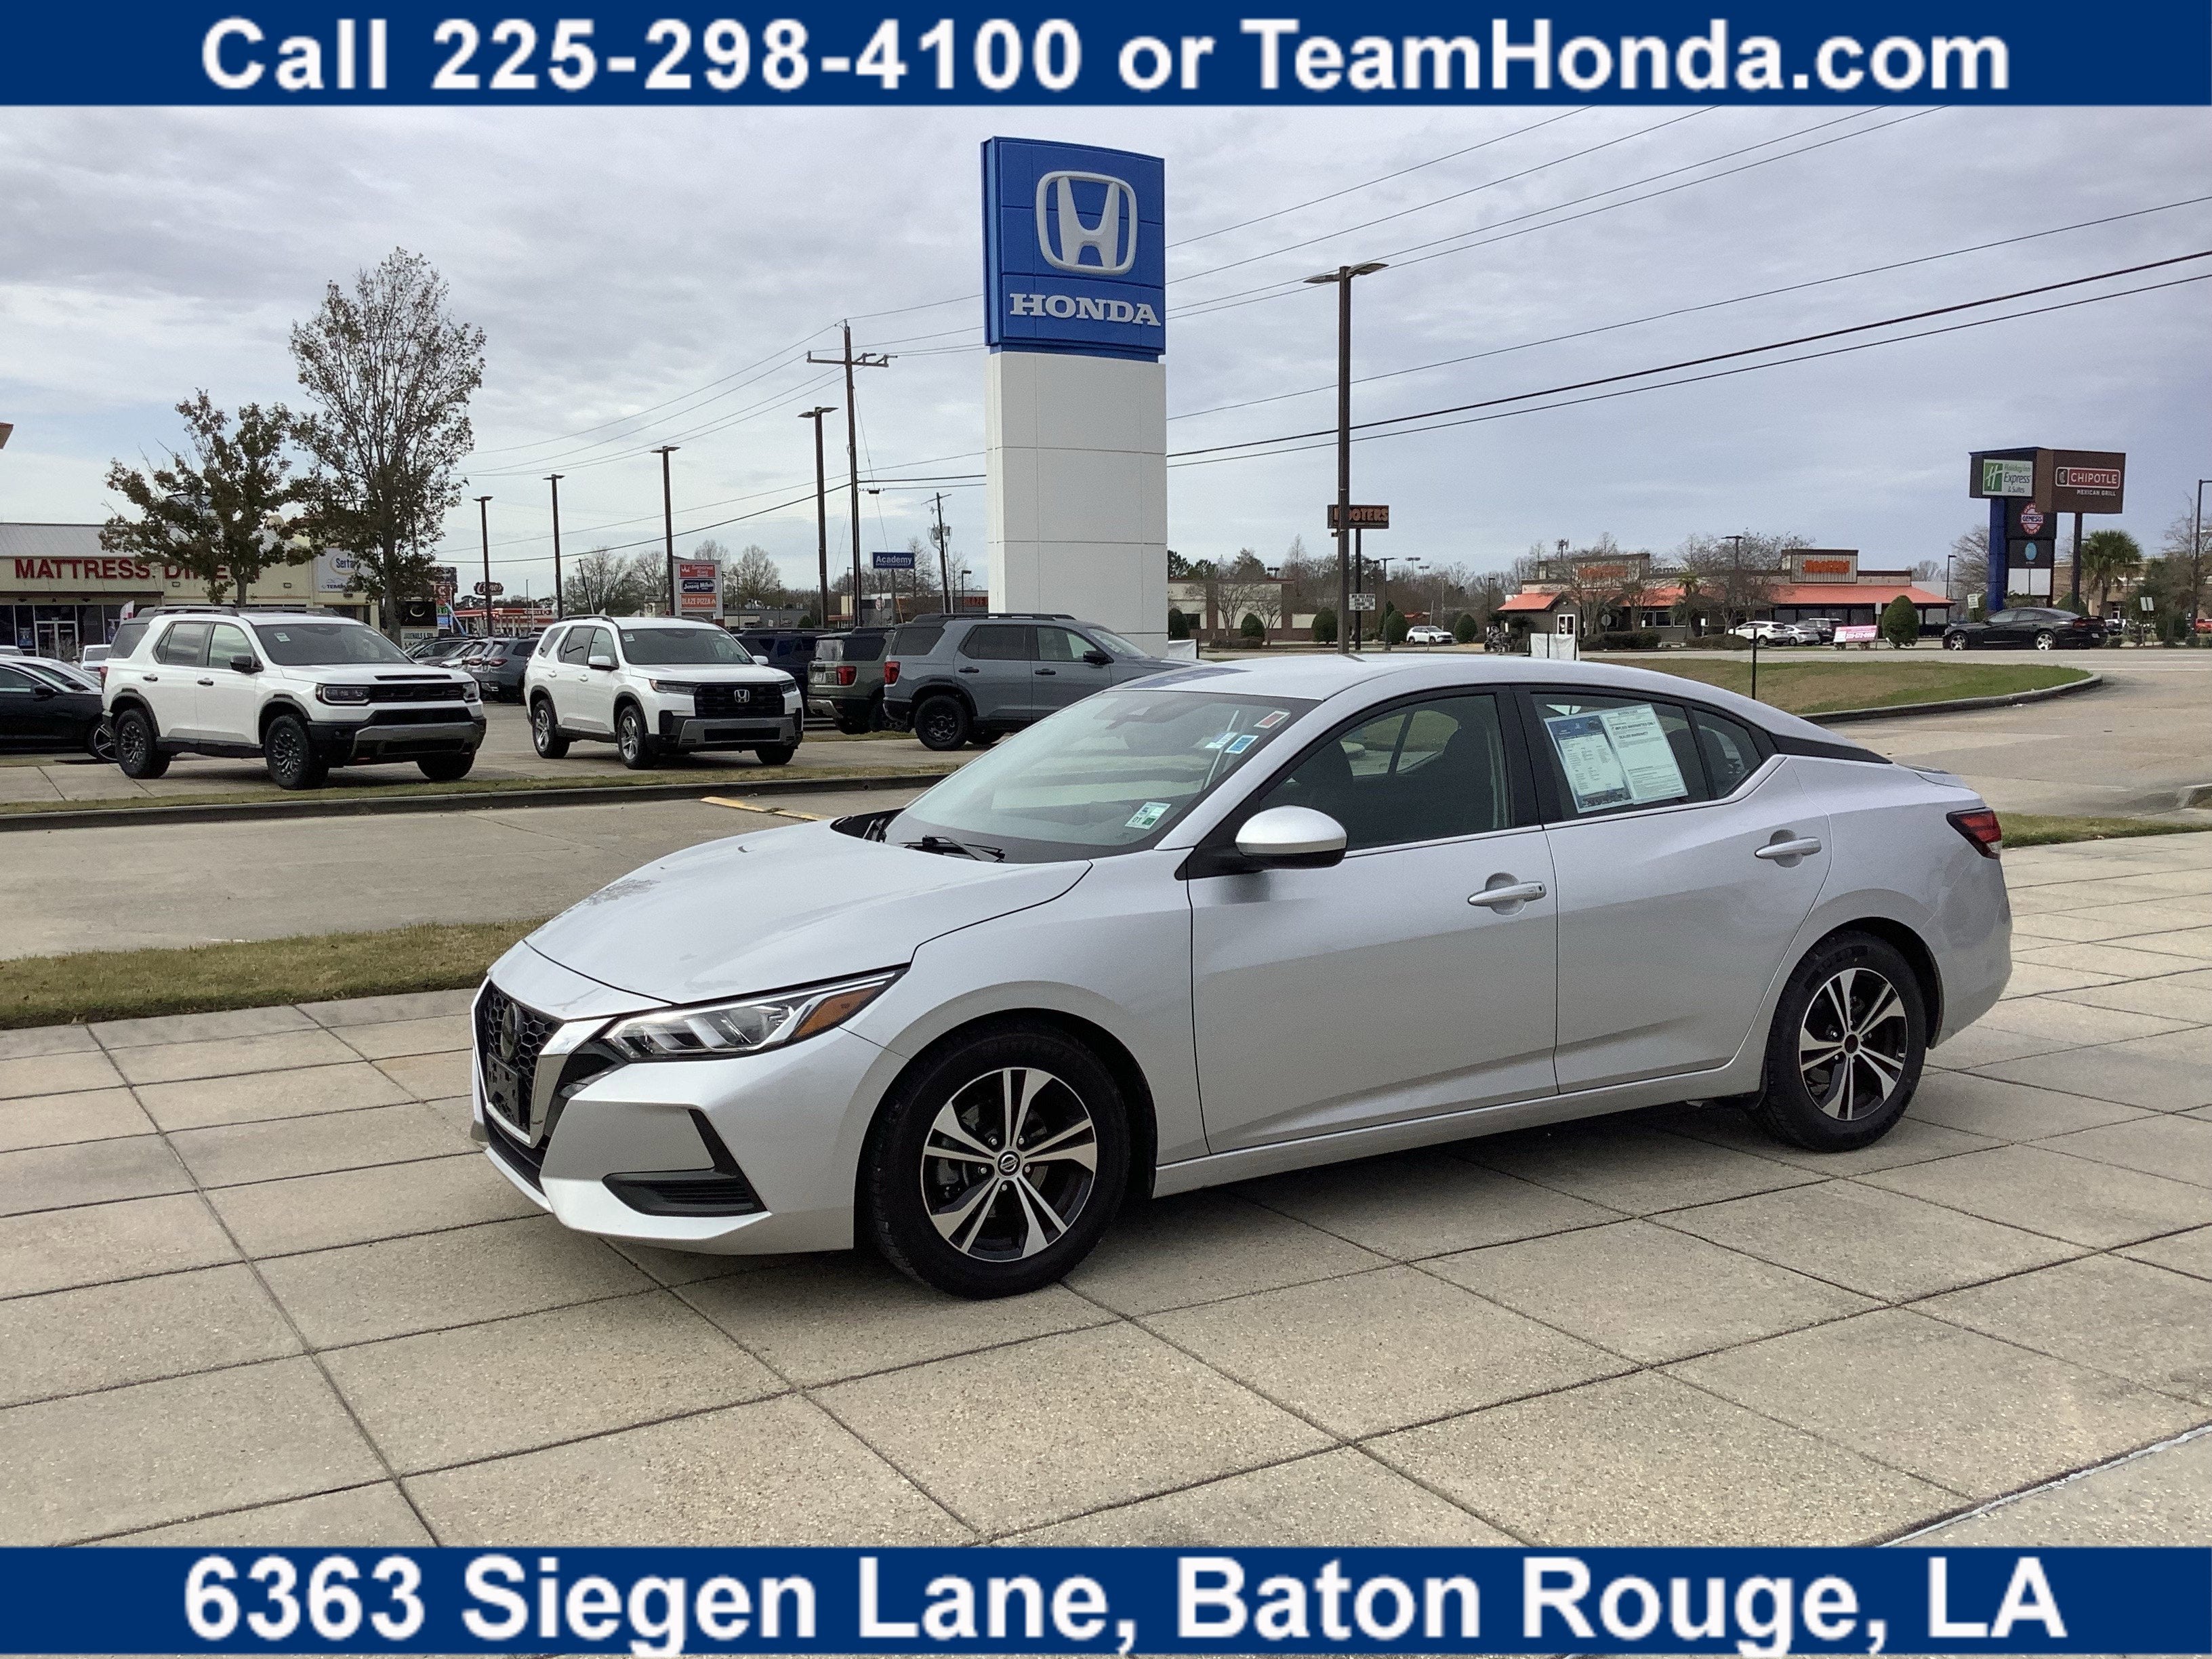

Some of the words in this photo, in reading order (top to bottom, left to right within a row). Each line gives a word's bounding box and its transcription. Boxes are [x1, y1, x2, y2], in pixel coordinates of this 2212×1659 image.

[1010, 293, 1161, 326] HONDA
[2004, 472, 2031, 485] Express
[2070, 472, 2117, 484] CHIPOTLE
[876, 556, 912, 565] Academy
[15, 559, 150, 579] MATTRESS
